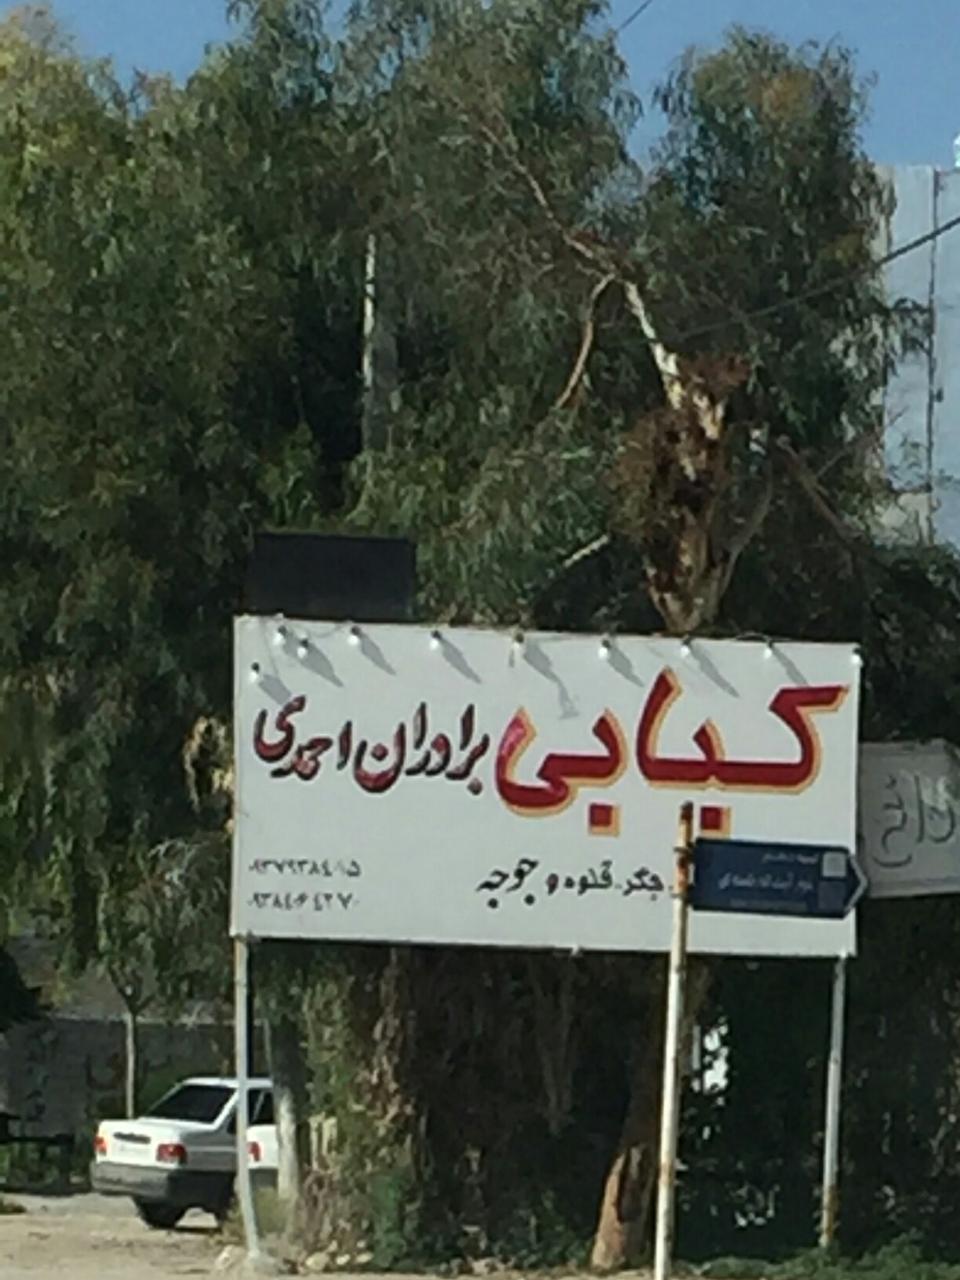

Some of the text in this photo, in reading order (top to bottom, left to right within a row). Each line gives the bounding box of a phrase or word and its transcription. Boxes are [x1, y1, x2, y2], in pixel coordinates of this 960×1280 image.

[253, 664, 850, 838] کبابی برادران احمدی
[473, 856, 542, 911] جوجه
[544, 871, 560, 897] و
[562, 857, 615, 897] قلوه
